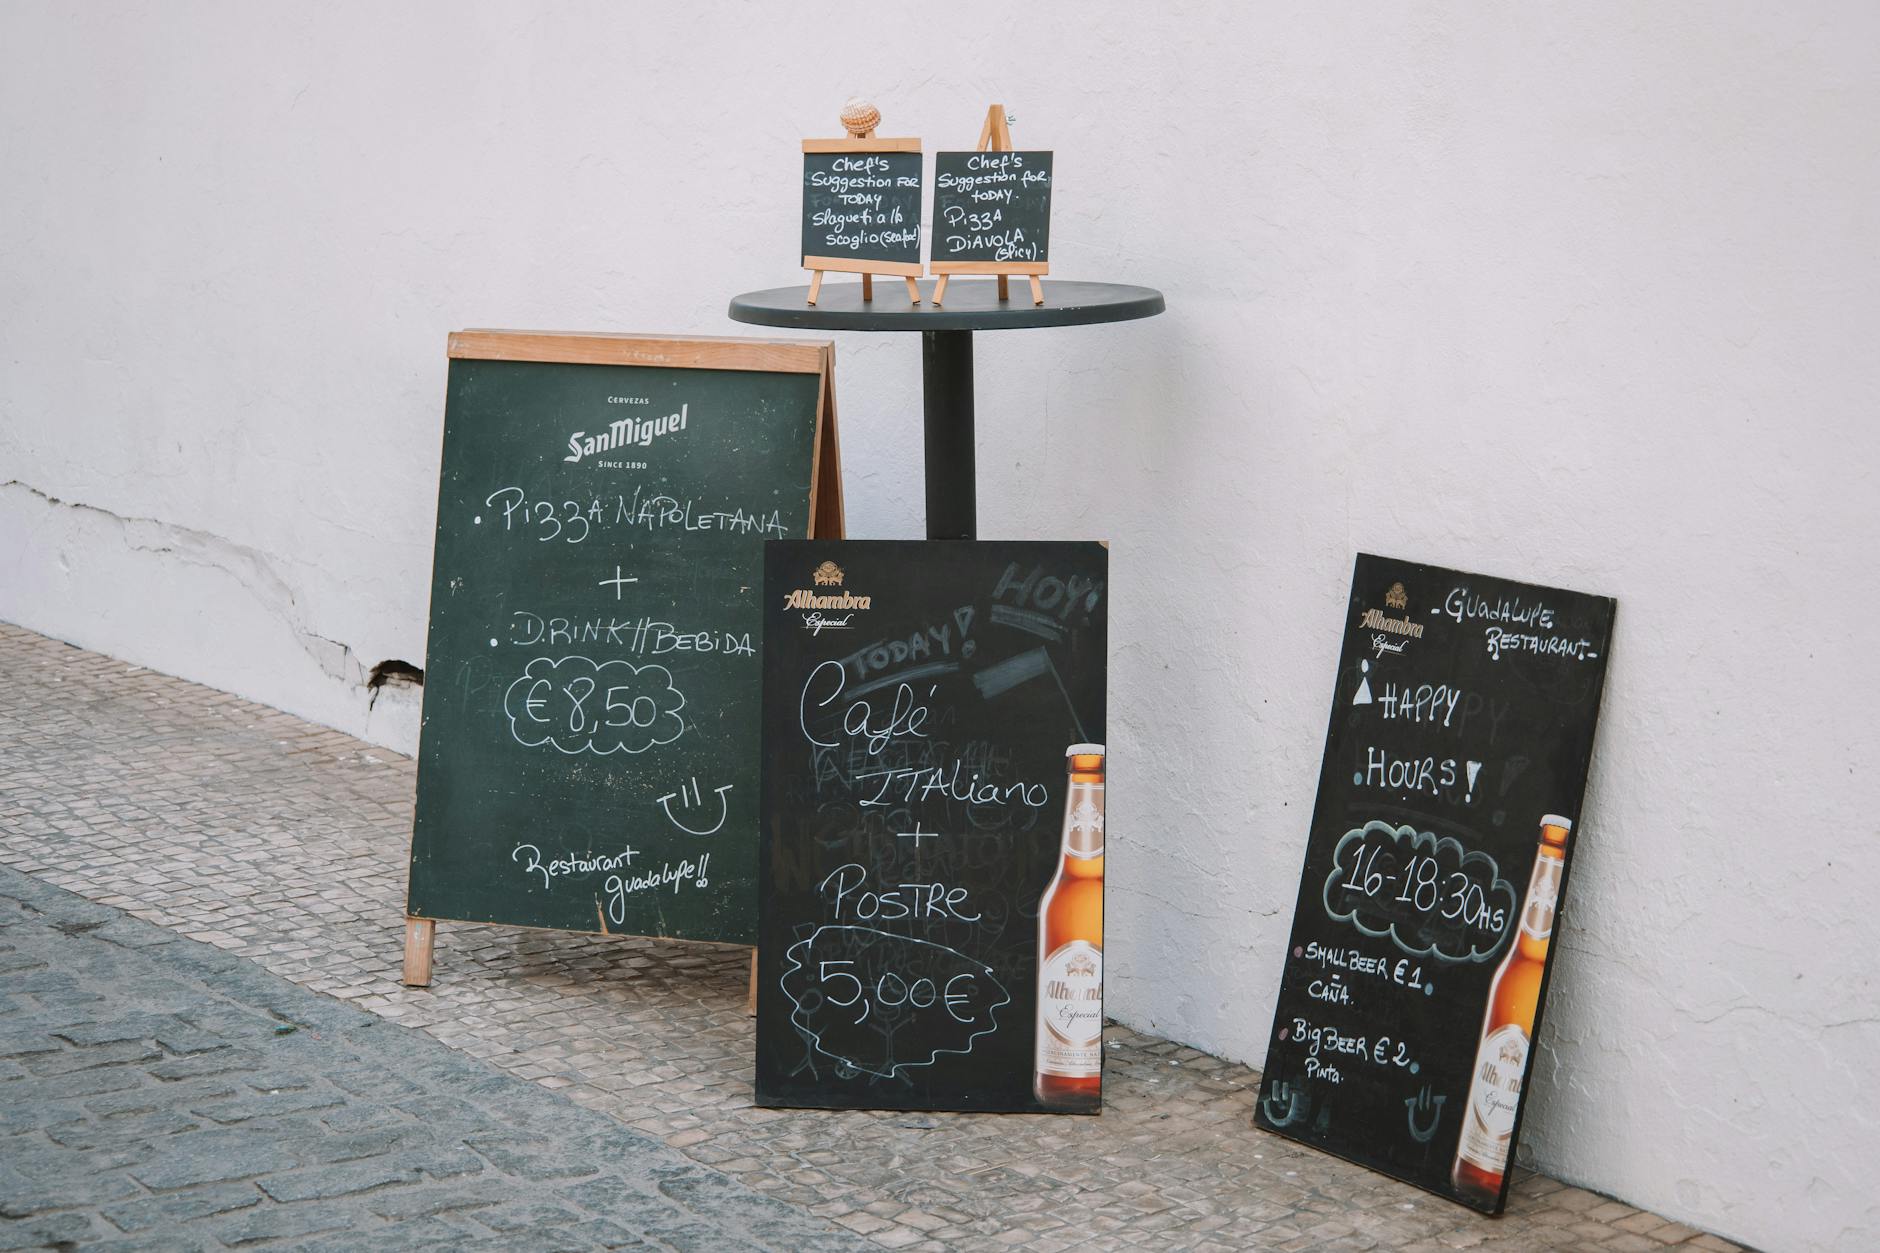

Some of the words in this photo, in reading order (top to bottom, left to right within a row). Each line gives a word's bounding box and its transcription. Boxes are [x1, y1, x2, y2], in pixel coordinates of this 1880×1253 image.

[832, 156, 890, 175] Chef's
[967, 153, 1023, 175] Chef's
[811, 171, 891, 193] Suggestion
[938, 171, 1017, 193] Suggestion
[838, 192, 882, 211] TODAY
[876, 213, 886, 224] a
[607, 396, 649, 405] CERVEZAS
[598, 460, 622, 468] SINCE
[625, 461, 647, 470] 1890
[783, 589, 871, 611] Alhambra
[801, 611, 854, 636] Especial
[1359, 608, 1424, 638] Alhambra
[1370, 633, 1409, 659] Especial
[800, 660, 937, 755] Café
[512, 844, 640, 889] Restaurant
[1348, 950, 1388, 980] BEER
[1292, 1018, 1321, 1056] Big
[1323, 1026, 1368, 1061] BEER
